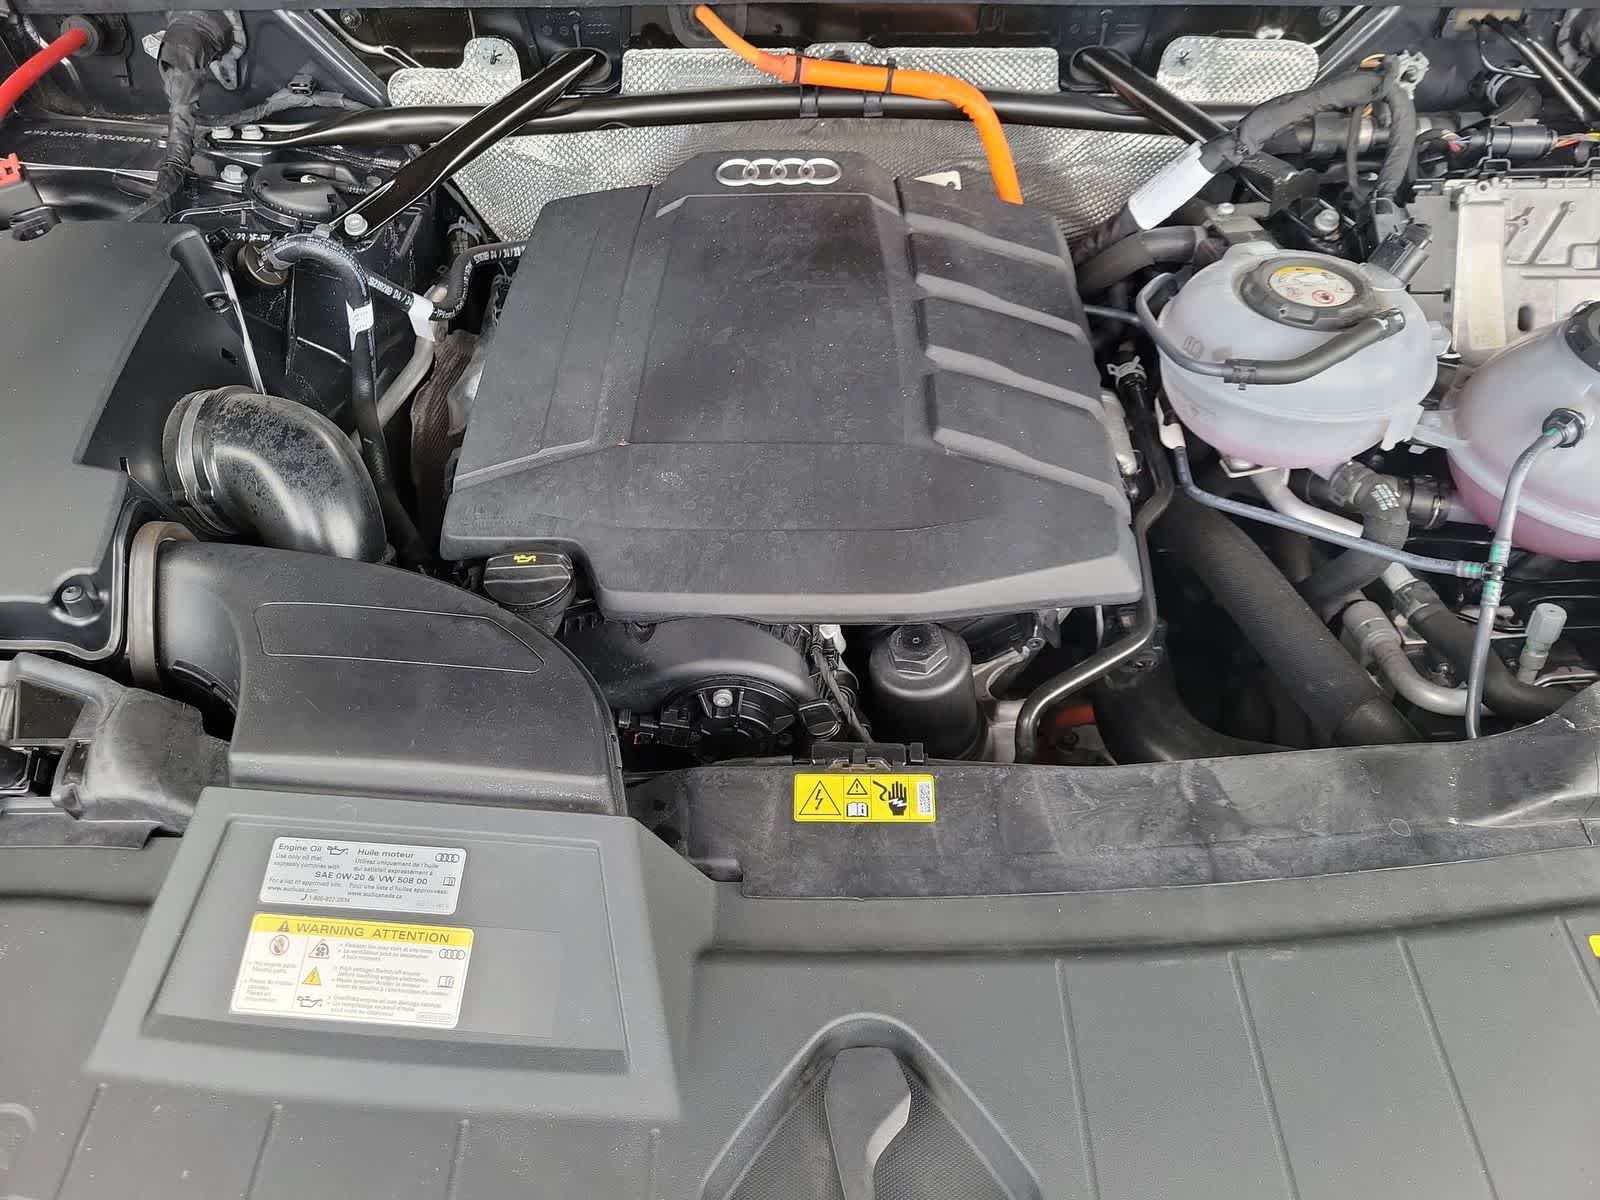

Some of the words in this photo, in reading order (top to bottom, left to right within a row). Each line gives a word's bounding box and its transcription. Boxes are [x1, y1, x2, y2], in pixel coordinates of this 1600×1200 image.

[278, 843, 308, 852] Engine
[357, 848, 379, 857] Huile
[381, 850, 415, 859] moteur
[314, 871, 334, 879] SAE
[335, 873, 366, 881] 0W-20
[378, 875, 395, 883] VW
[397, 876, 414, 885] 508
[296, 923, 365, 937] WARNING
[371, 928, 451, 943] ATTENTION
